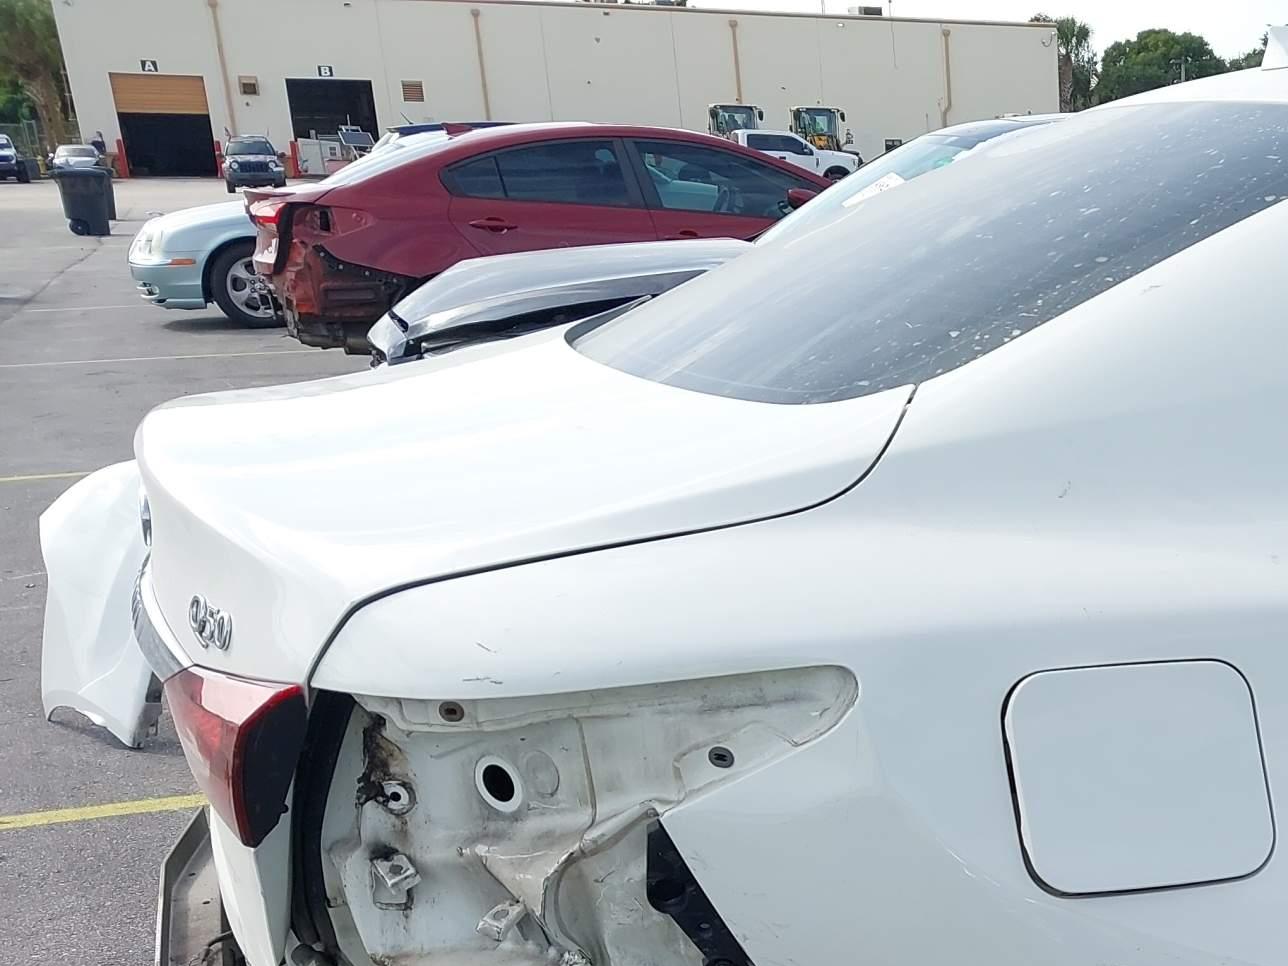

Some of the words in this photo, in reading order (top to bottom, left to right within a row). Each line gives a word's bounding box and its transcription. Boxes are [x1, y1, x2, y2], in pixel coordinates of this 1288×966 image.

[144, 60, 155, 71] A
[320, 66, 331, 76] B
[189, 594, 233, 651] Q50
